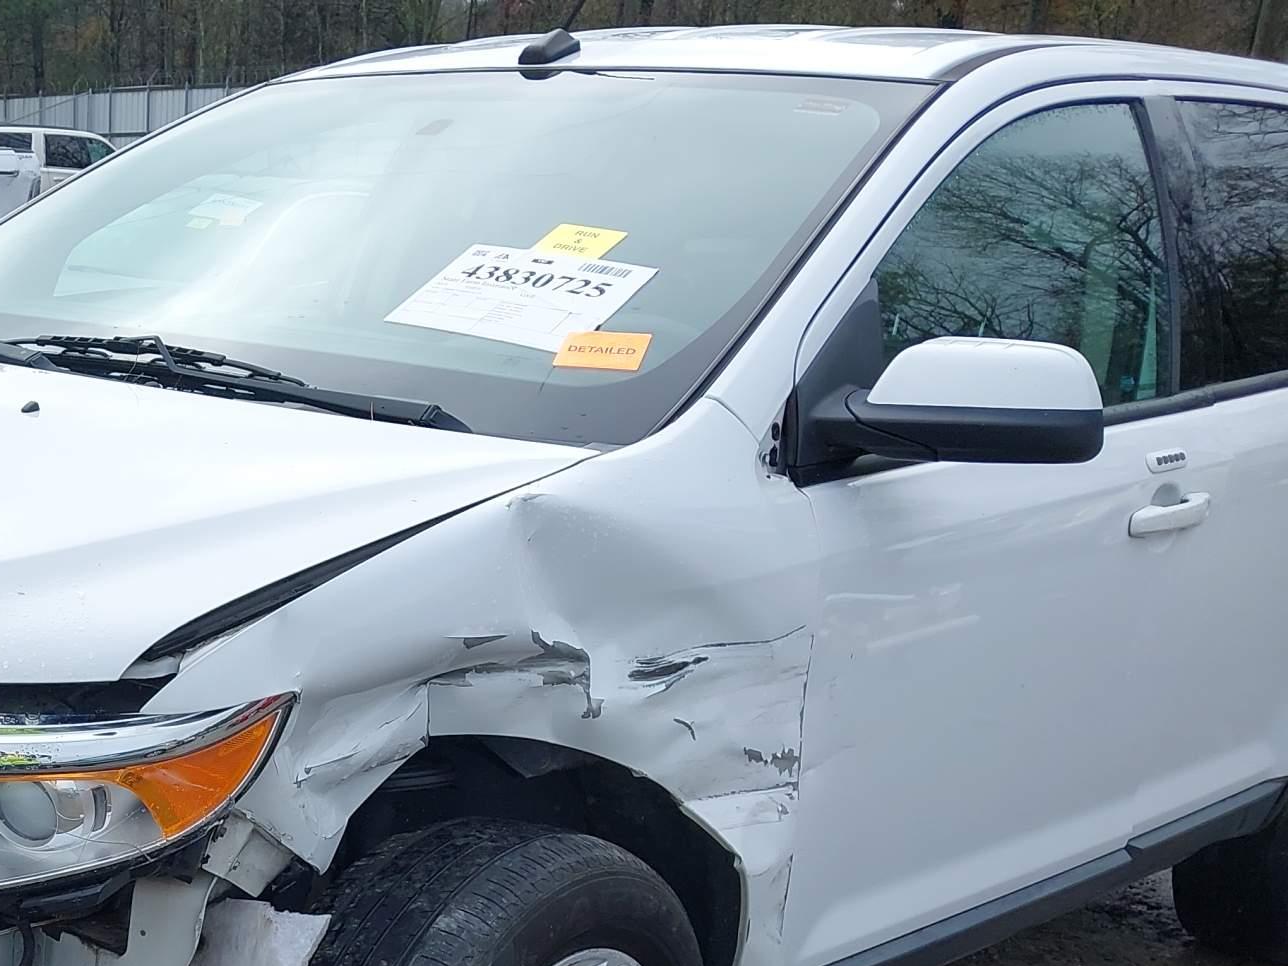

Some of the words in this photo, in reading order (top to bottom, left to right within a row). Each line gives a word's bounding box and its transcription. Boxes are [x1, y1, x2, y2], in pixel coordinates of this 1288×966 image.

[574, 230, 601, 239] RUN
[553, 243, 589, 253] DRIVE
[460, 263, 614, 298] 43830725
[567, 344, 637, 355] DETAILED
